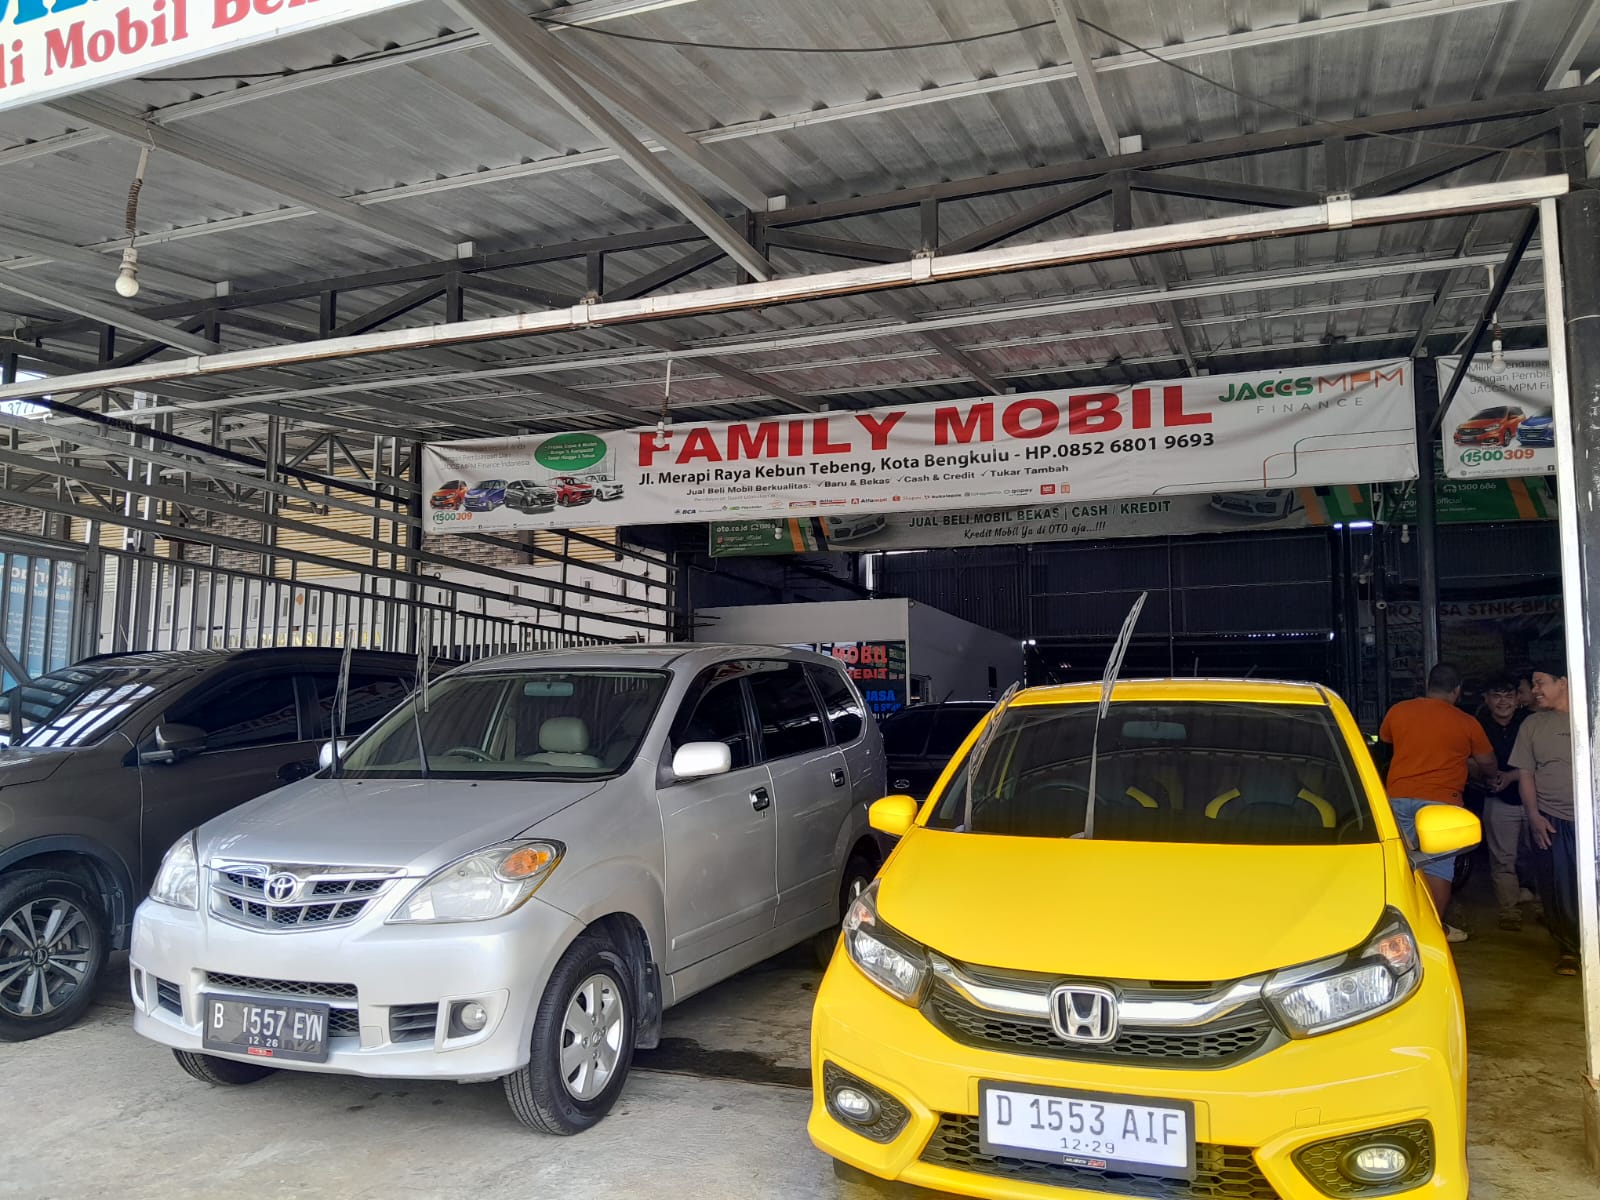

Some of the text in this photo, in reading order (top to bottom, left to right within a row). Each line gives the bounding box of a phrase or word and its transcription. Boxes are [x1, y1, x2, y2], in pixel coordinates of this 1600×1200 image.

[44, 0, 189, 76] Mobil
[1509, 382, 1537, 393] MPM
[1256, 396, 1365, 415] FINANCE
[638, 411, 907, 467] FAMILY
[934, 386, 1213, 446] MOBIL
[638, 472, 655, 486] Jl.
[658, 469, 710, 485] Merapi
[714, 468, 751, 483] Raya
[755, 465, 806, 479] Kebun
[809, 460, 876, 475] Tebeng,
[880, 457, 920, 471] Kota
[924, 448, 1010, 469] Bengkulu
[1025, 441, 1105, 460] HP.0852
[1110, 436, 1157, 454] 6801
[1164, 432, 1215, 449] 9693
[686, 487, 706, 496] Jual
[707, 486, 725, 495] Beli
[727, 485, 753, 494] Mobil
[755, 483, 811, 492] Berkualitas:
[849, 479, 857, 487] &
[859, 478, 891, 486] Bekas
[903, 475, 930, 483] Cash
[943, 472, 975, 481] Credit
[990, 468, 1020, 477] Tukar
[1023, 464, 1069, 475] Tambah
[908, 516, 939, 528] JUAL
[942, 514, 971, 526] BELI
[974, 512, 1013, 525] MOBIL
[1017, 508, 1060, 521] BEKAS
[1071, 505, 1108, 518] CASH
[1120, 500, 1171, 514] KREDIT
[963, 527, 992, 539] Kredit
[994, 526, 1019, 537] Mobil
[1037, 524, 1046, 535] di
[1048, 523, 1068, 534] OTO
[846, 667, 889, 680] REDIT
[865, 689, 896, 702] JASA
[213, 1002, 324, 1043] B 1557 EYN
[996, 1094, 1179, 1145] D 1553 AIF
